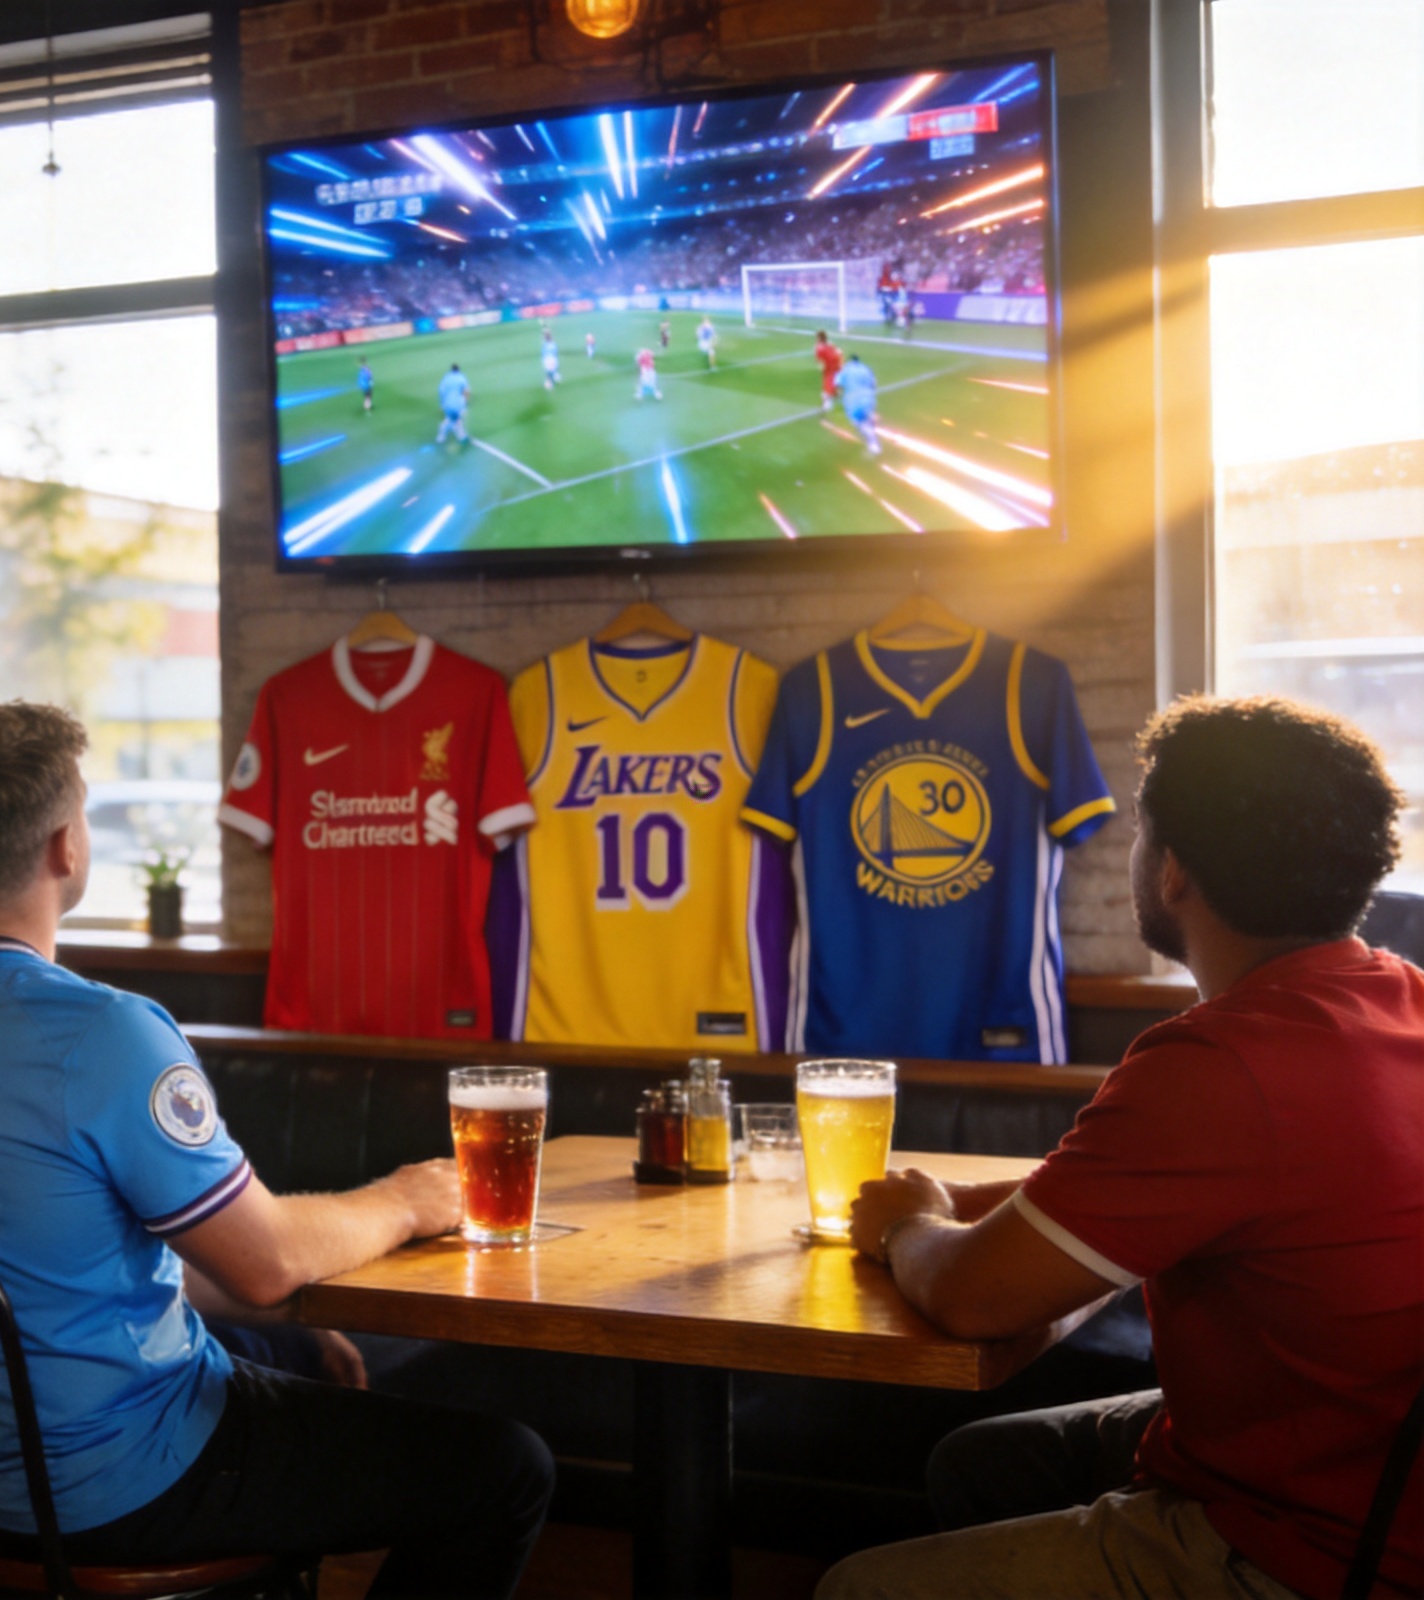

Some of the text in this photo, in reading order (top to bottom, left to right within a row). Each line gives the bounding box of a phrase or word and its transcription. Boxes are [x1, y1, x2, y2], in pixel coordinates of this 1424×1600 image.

[553, 744, 723, 810] LAKERS
[918, 779, 966, 816] 30
[595, 811, 689, 912] 10
[855, 859, 995, 909] WARRIORS
